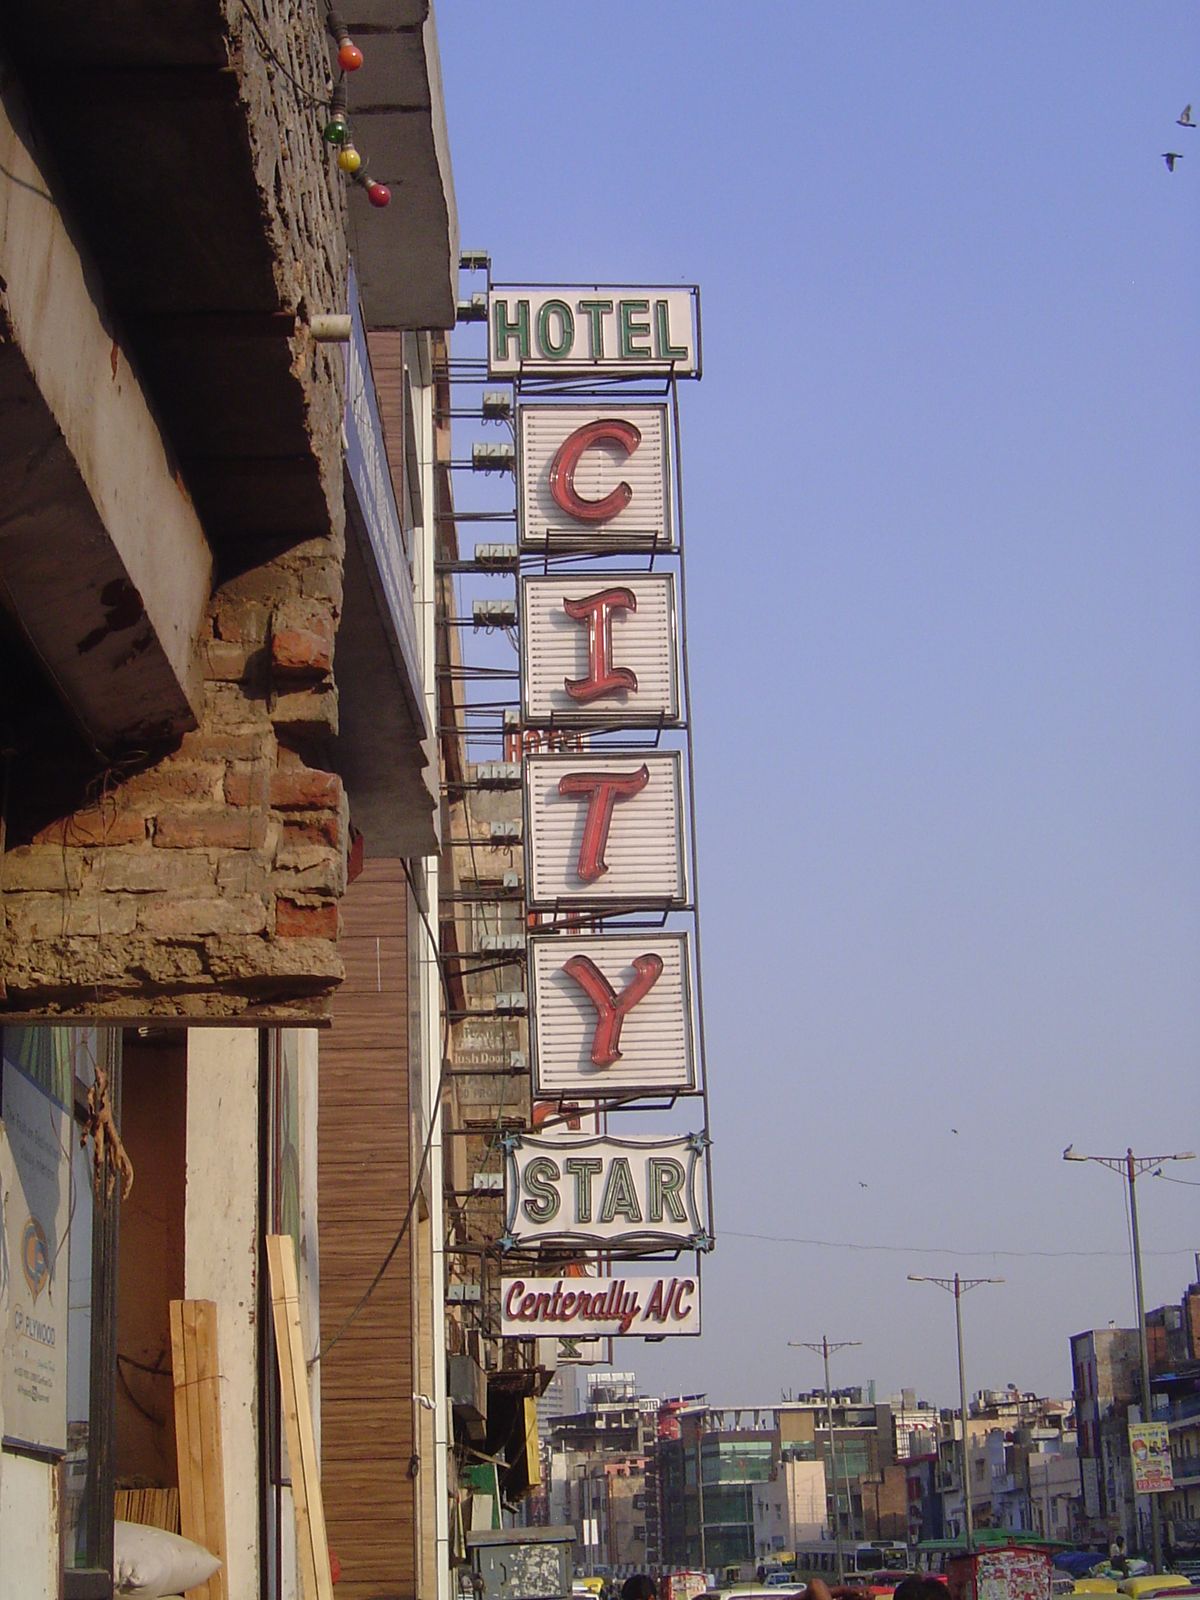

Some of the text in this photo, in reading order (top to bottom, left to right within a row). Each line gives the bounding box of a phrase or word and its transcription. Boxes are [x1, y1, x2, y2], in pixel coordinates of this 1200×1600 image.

[494, 299, 689, 360] HOTEL
[523, 1156, 688, 1224] STAR
[25, 1315, 56, 1346] PLYWOOD
[505, 1278, 695, 1333] Centerally A/C
